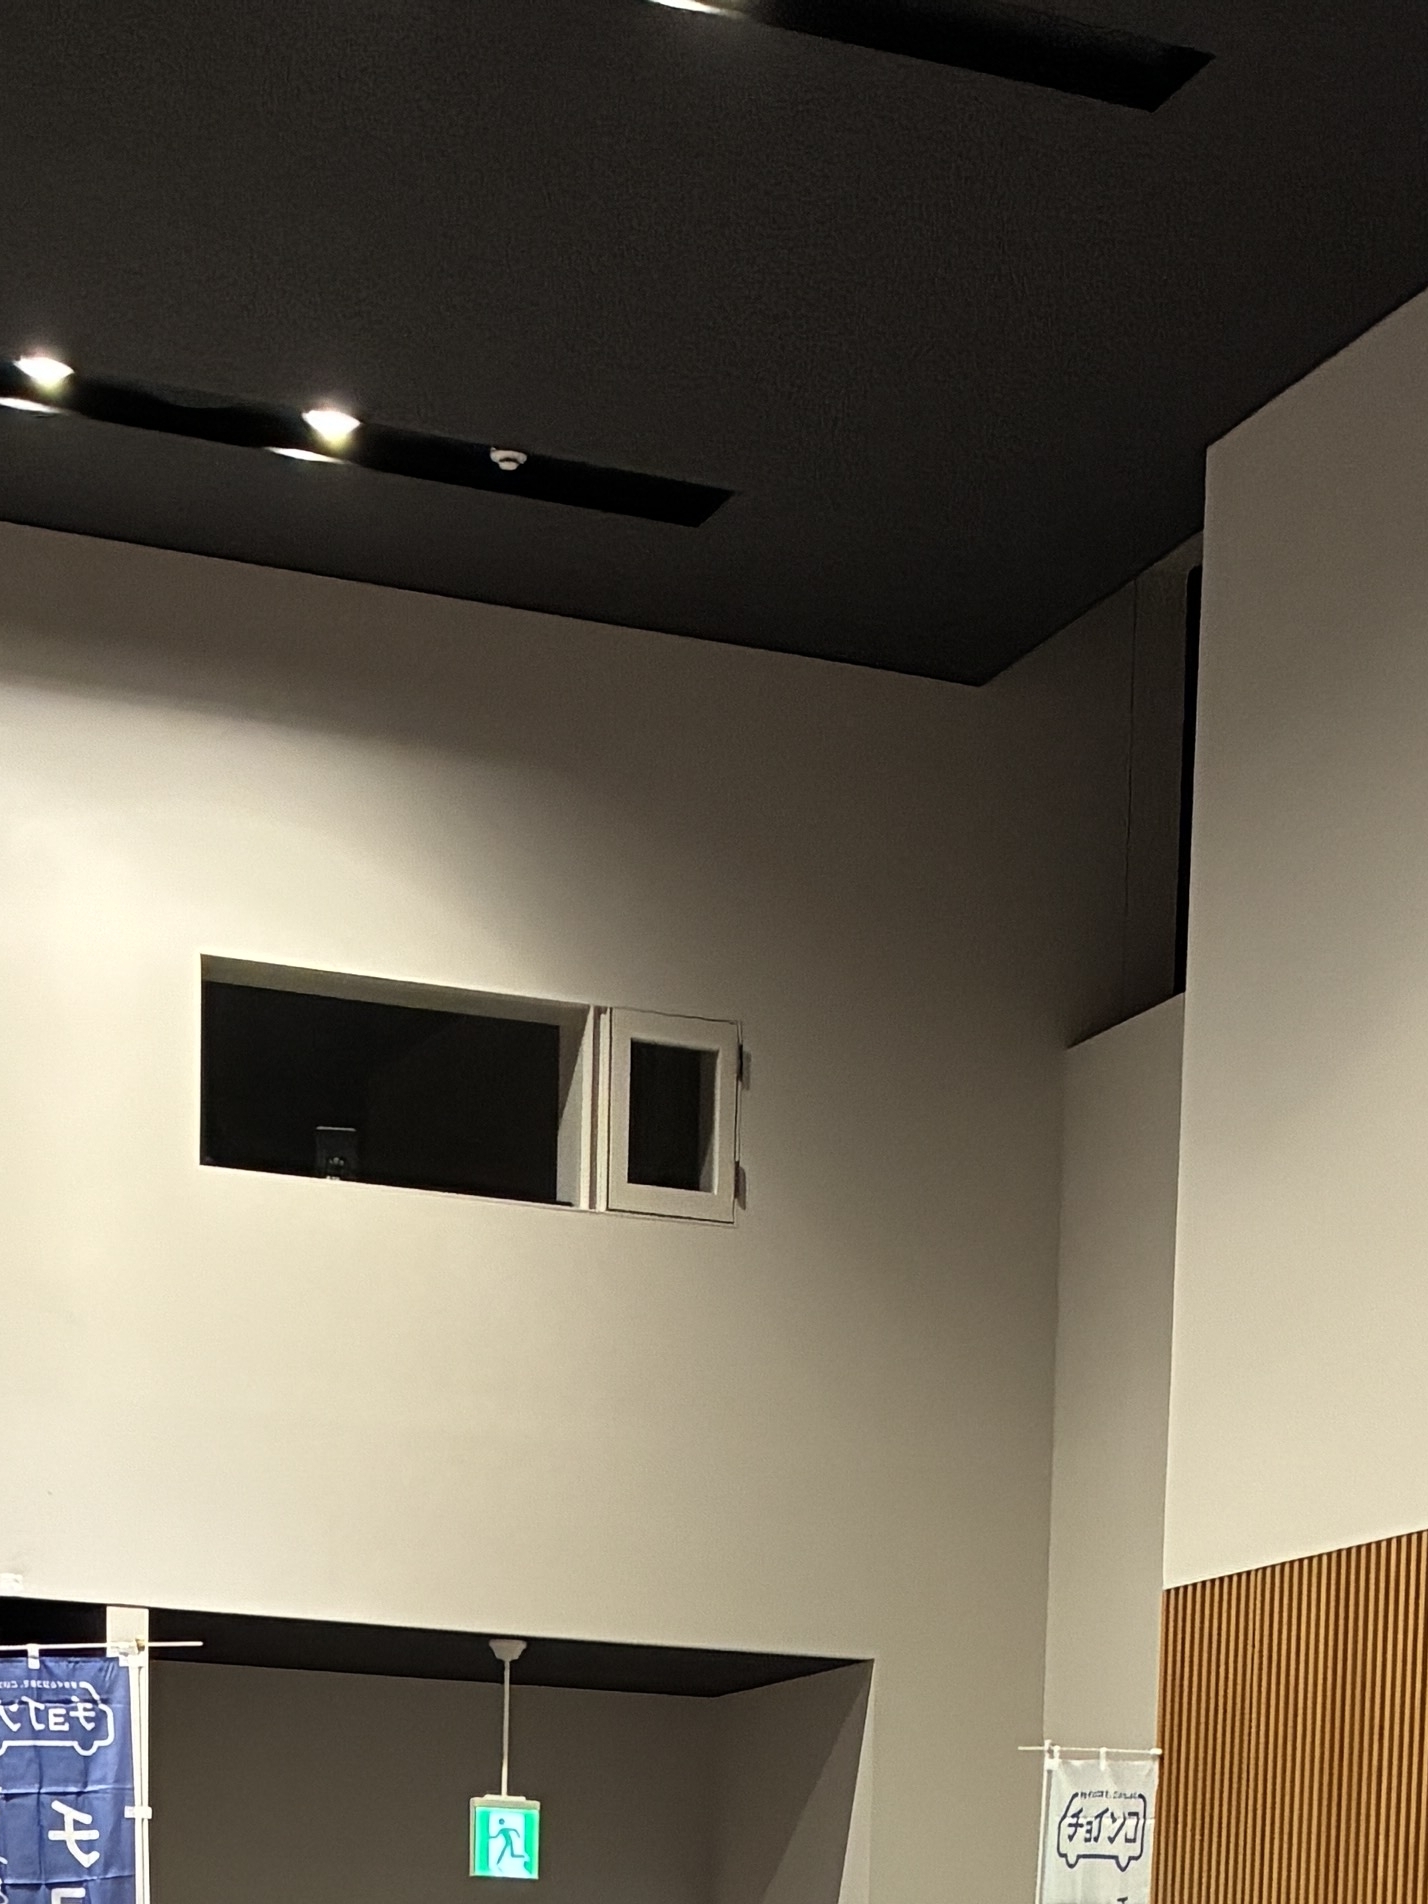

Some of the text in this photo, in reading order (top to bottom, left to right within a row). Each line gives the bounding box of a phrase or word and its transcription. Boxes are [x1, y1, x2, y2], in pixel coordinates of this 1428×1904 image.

[1067, 1806, 1140, 1845] チョイソコ
